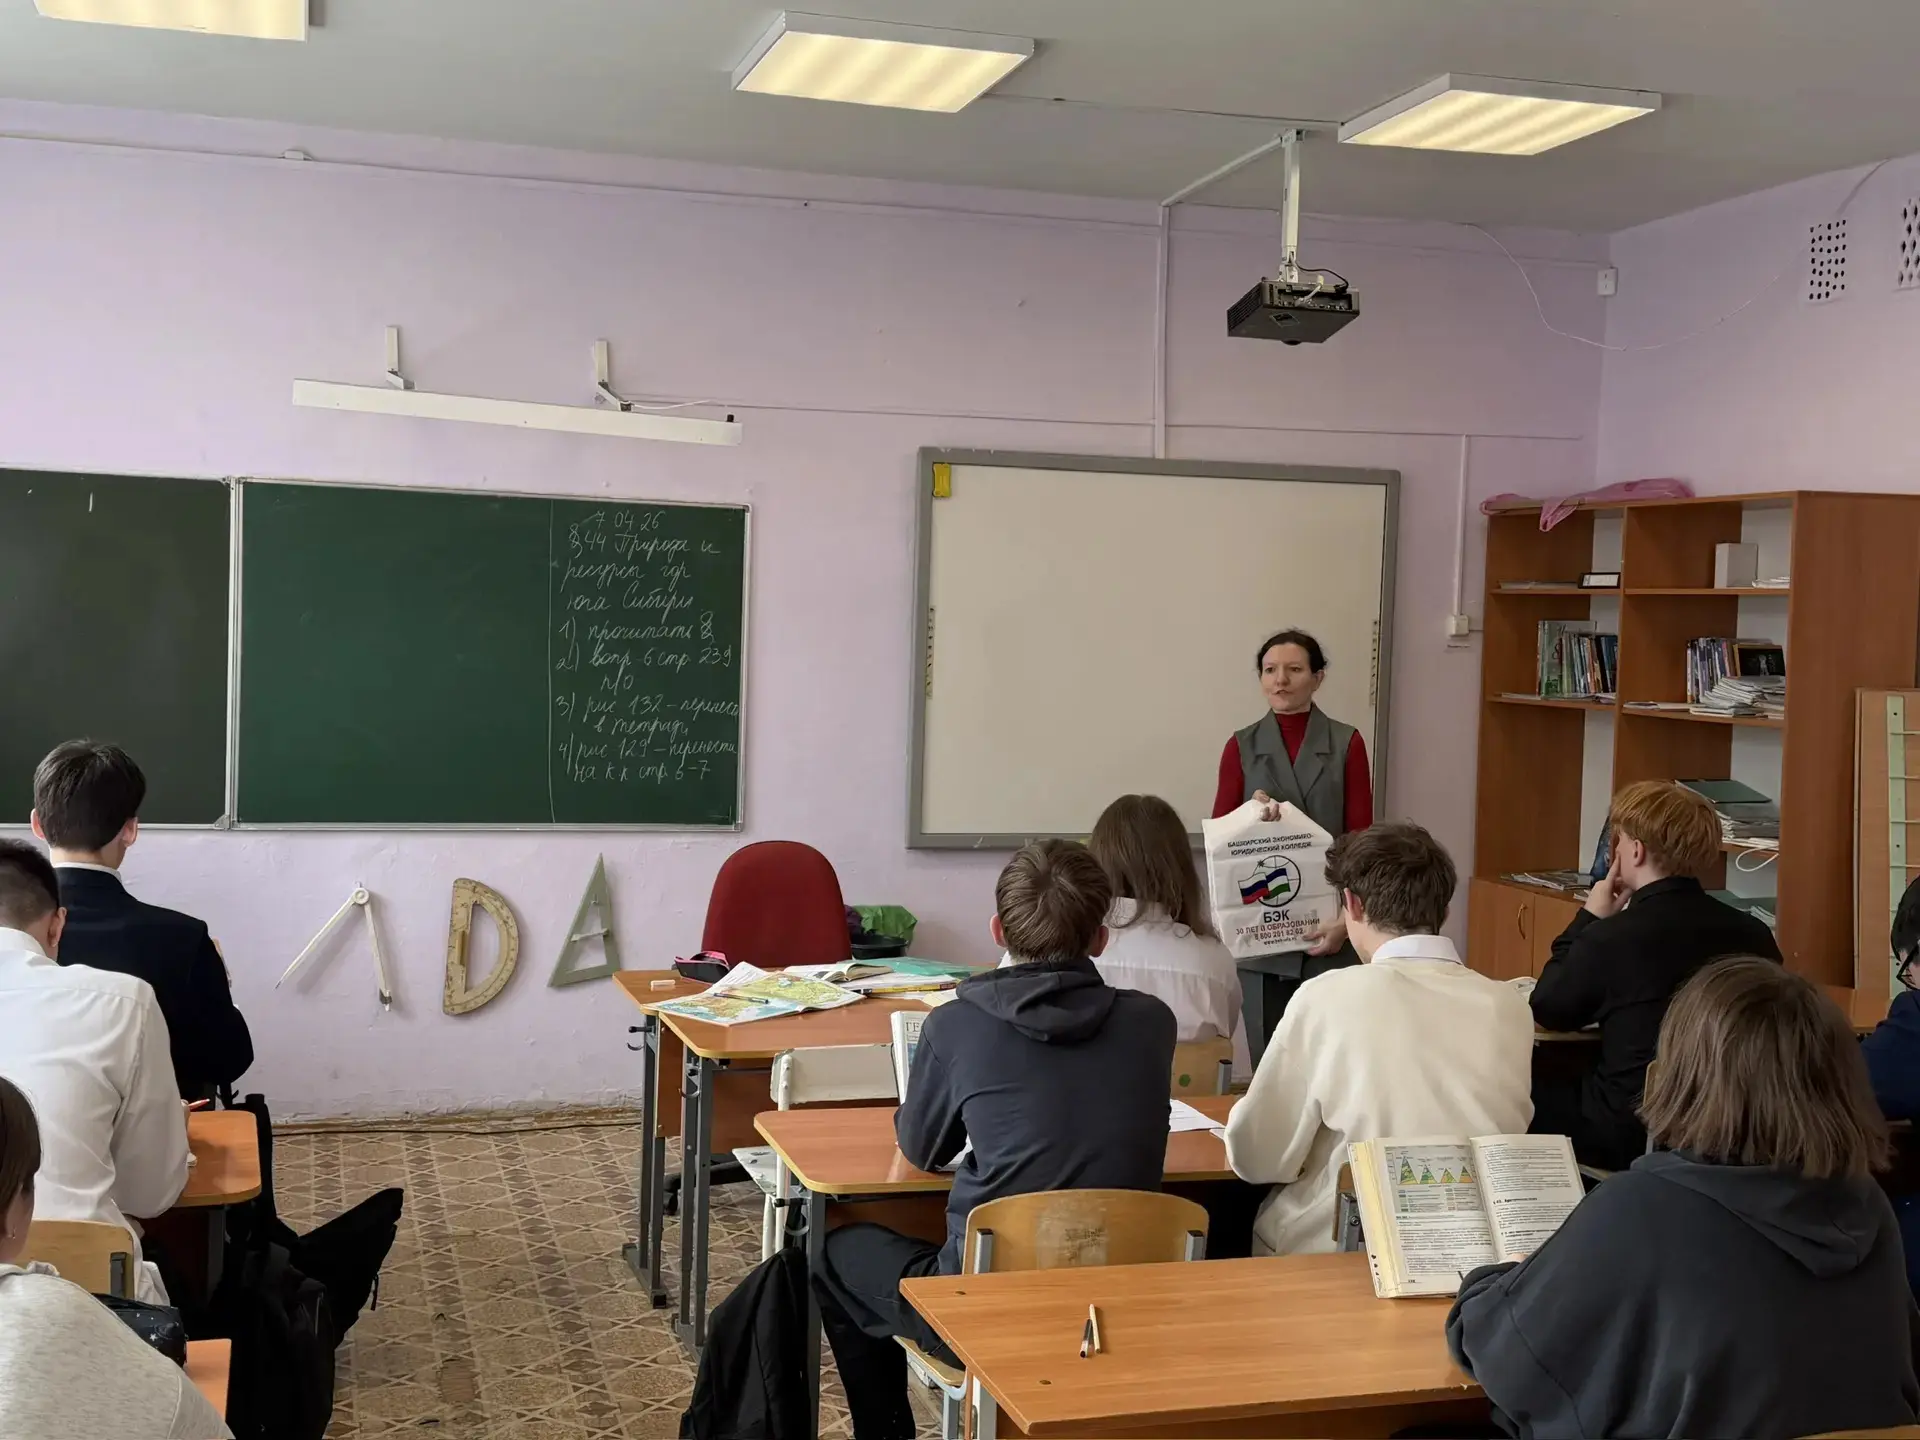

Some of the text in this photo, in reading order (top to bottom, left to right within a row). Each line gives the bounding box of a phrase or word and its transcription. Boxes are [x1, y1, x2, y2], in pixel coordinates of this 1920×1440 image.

[614, 510, 634, 530] 04
[640, 510, 666, 531] 26
[614, 529, 691, 563] Природа
[701, 539, 721, 554] и
[560, 558, 645, 593] ресурсы
[555, 642, 579, 673] 2)
[698, 645, 732, 668] 239
[555, 691, 575, 722] 3)
[628, 694, 664, 716] 132
[618, 738, 649, 759] 129
[1227, 837, 1272, 848] БАШКИРСКИЙ
[1231, 841, 1312, 856] ЮРИДИЧЕСКИЙ КОЛЛЕДЖ
[1246, 925, 1259, 934] ЛЕТ
[1266, 918, 1320, 931] ОБРАЗОВАНИИ
[1263, 909, 1290, 923] БЭК
[1260, 932, 1272, 940] 800
[1273, 930, 1284, 938] 201
